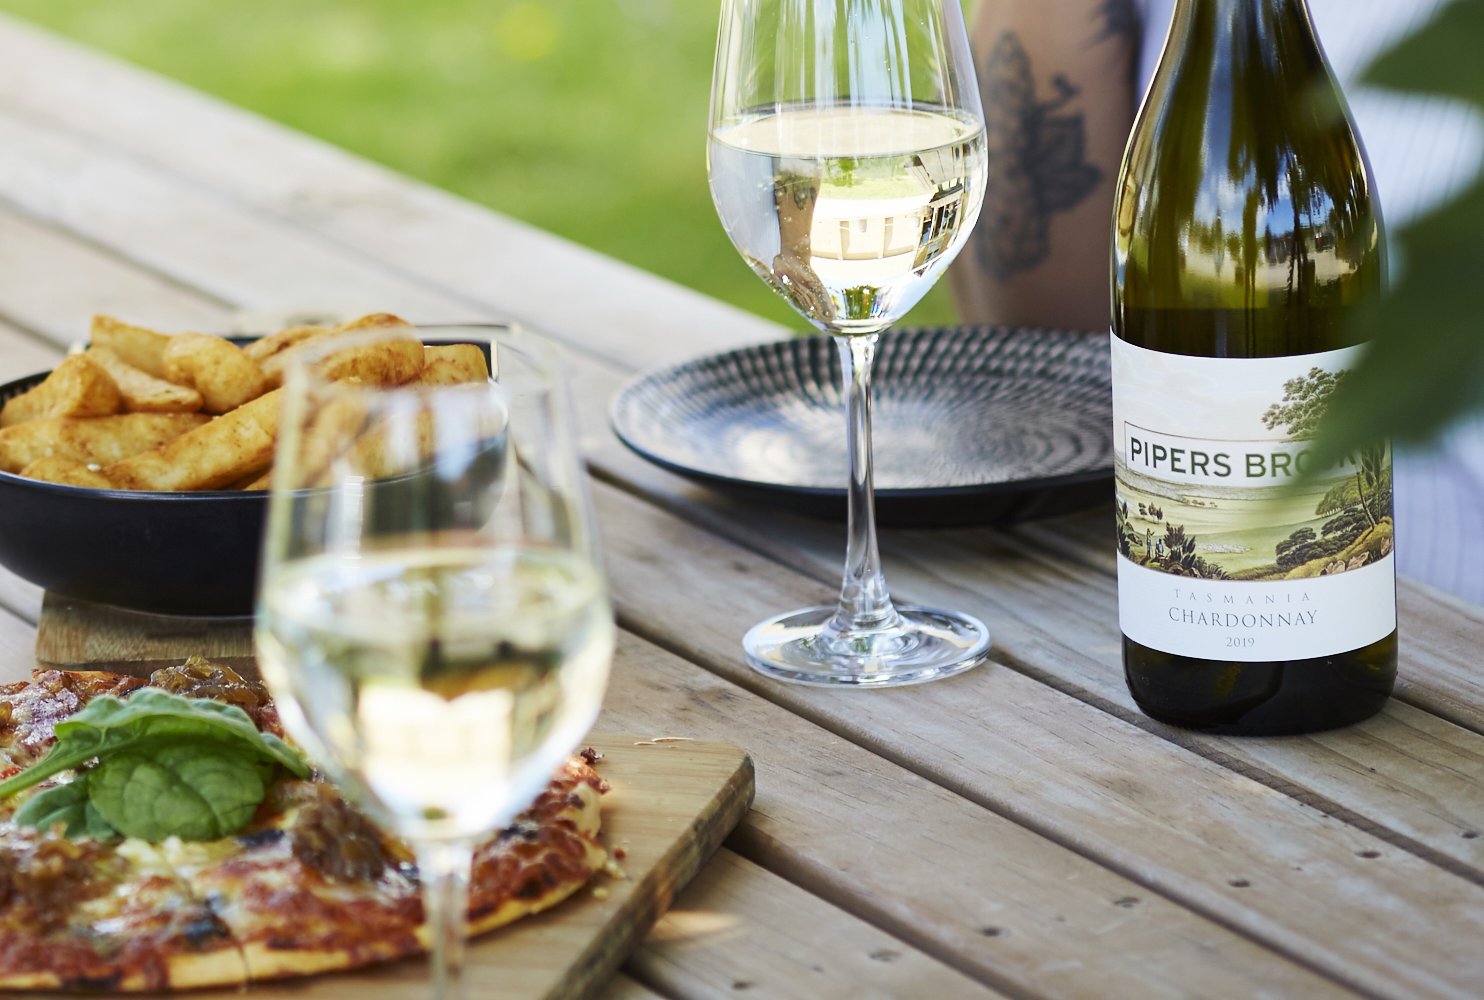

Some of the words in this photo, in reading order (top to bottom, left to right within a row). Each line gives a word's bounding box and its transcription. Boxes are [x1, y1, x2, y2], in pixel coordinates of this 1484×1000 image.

[1131, 437, 1232, 478] PIPERS
[1173, 588, 1310, 604] TASMANIA
[1168, 606, 1318, 628] CHARDONNAY
[1226, 636, 1255, 648] 2019
